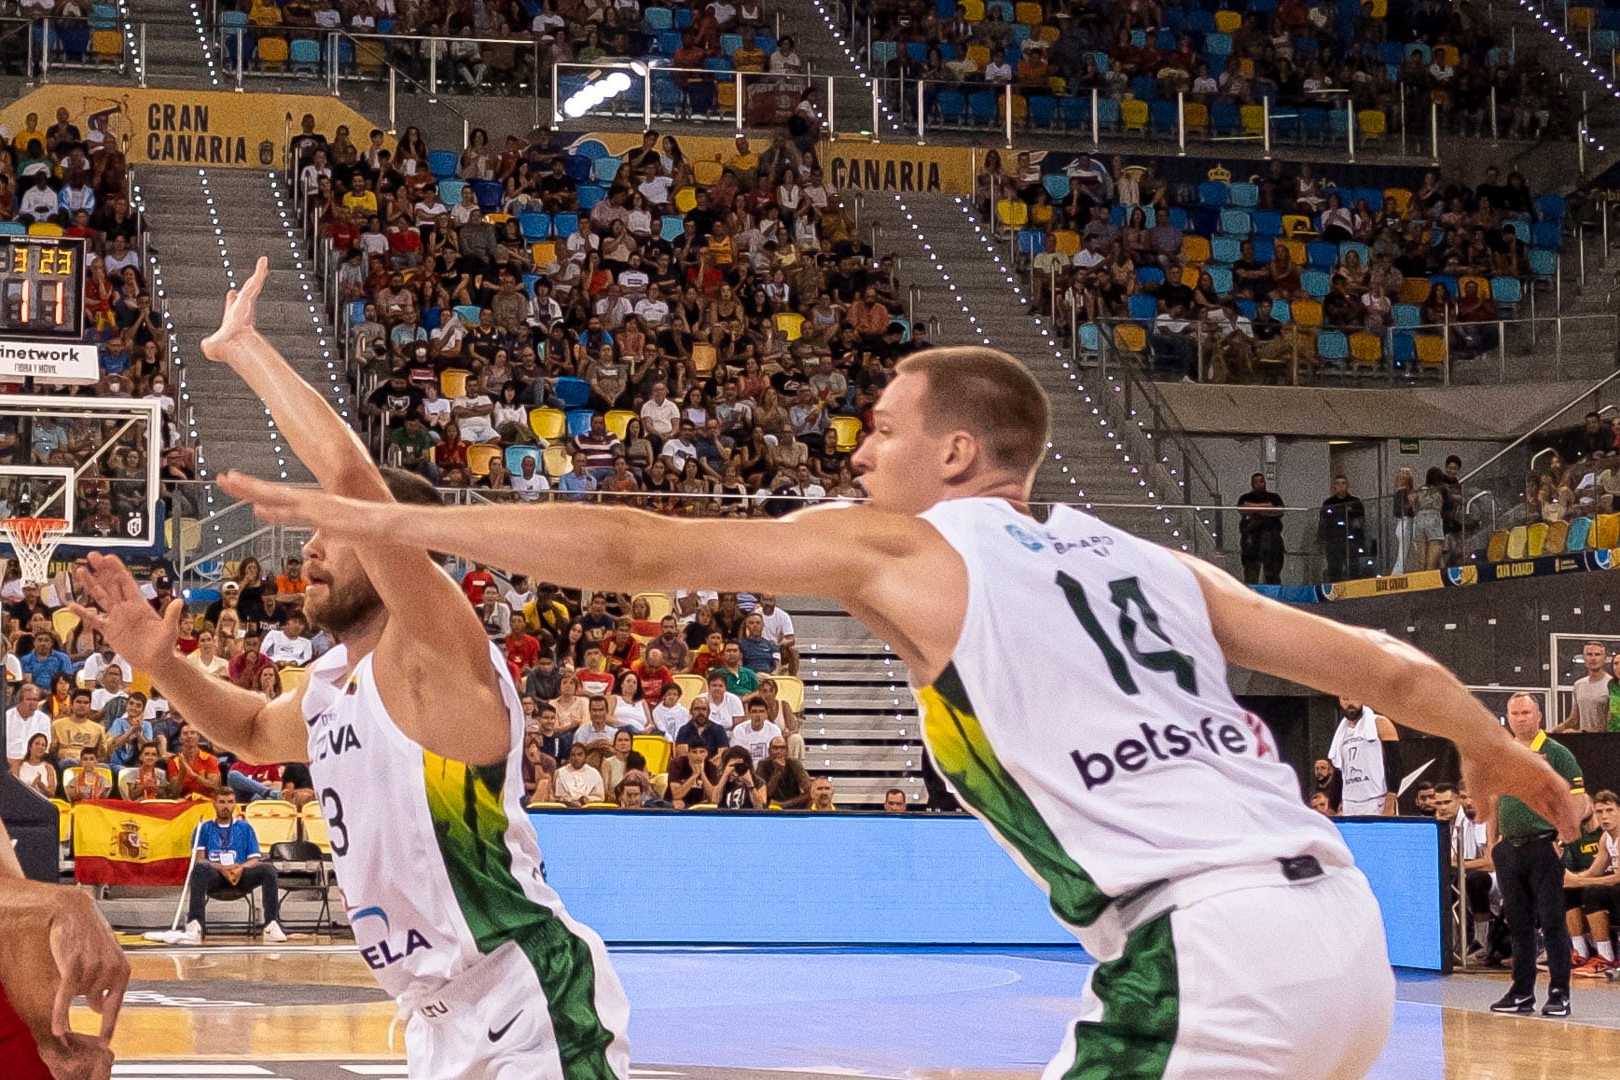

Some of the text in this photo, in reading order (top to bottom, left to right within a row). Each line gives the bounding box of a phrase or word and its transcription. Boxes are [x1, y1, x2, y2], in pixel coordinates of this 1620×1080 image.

[148, 103, 208, 132] GRAN
[147, 133, 247, 163] CANARIA
[831, 157, 941, 192] CANARIA
[1055, 570, 1200, 697] 14
